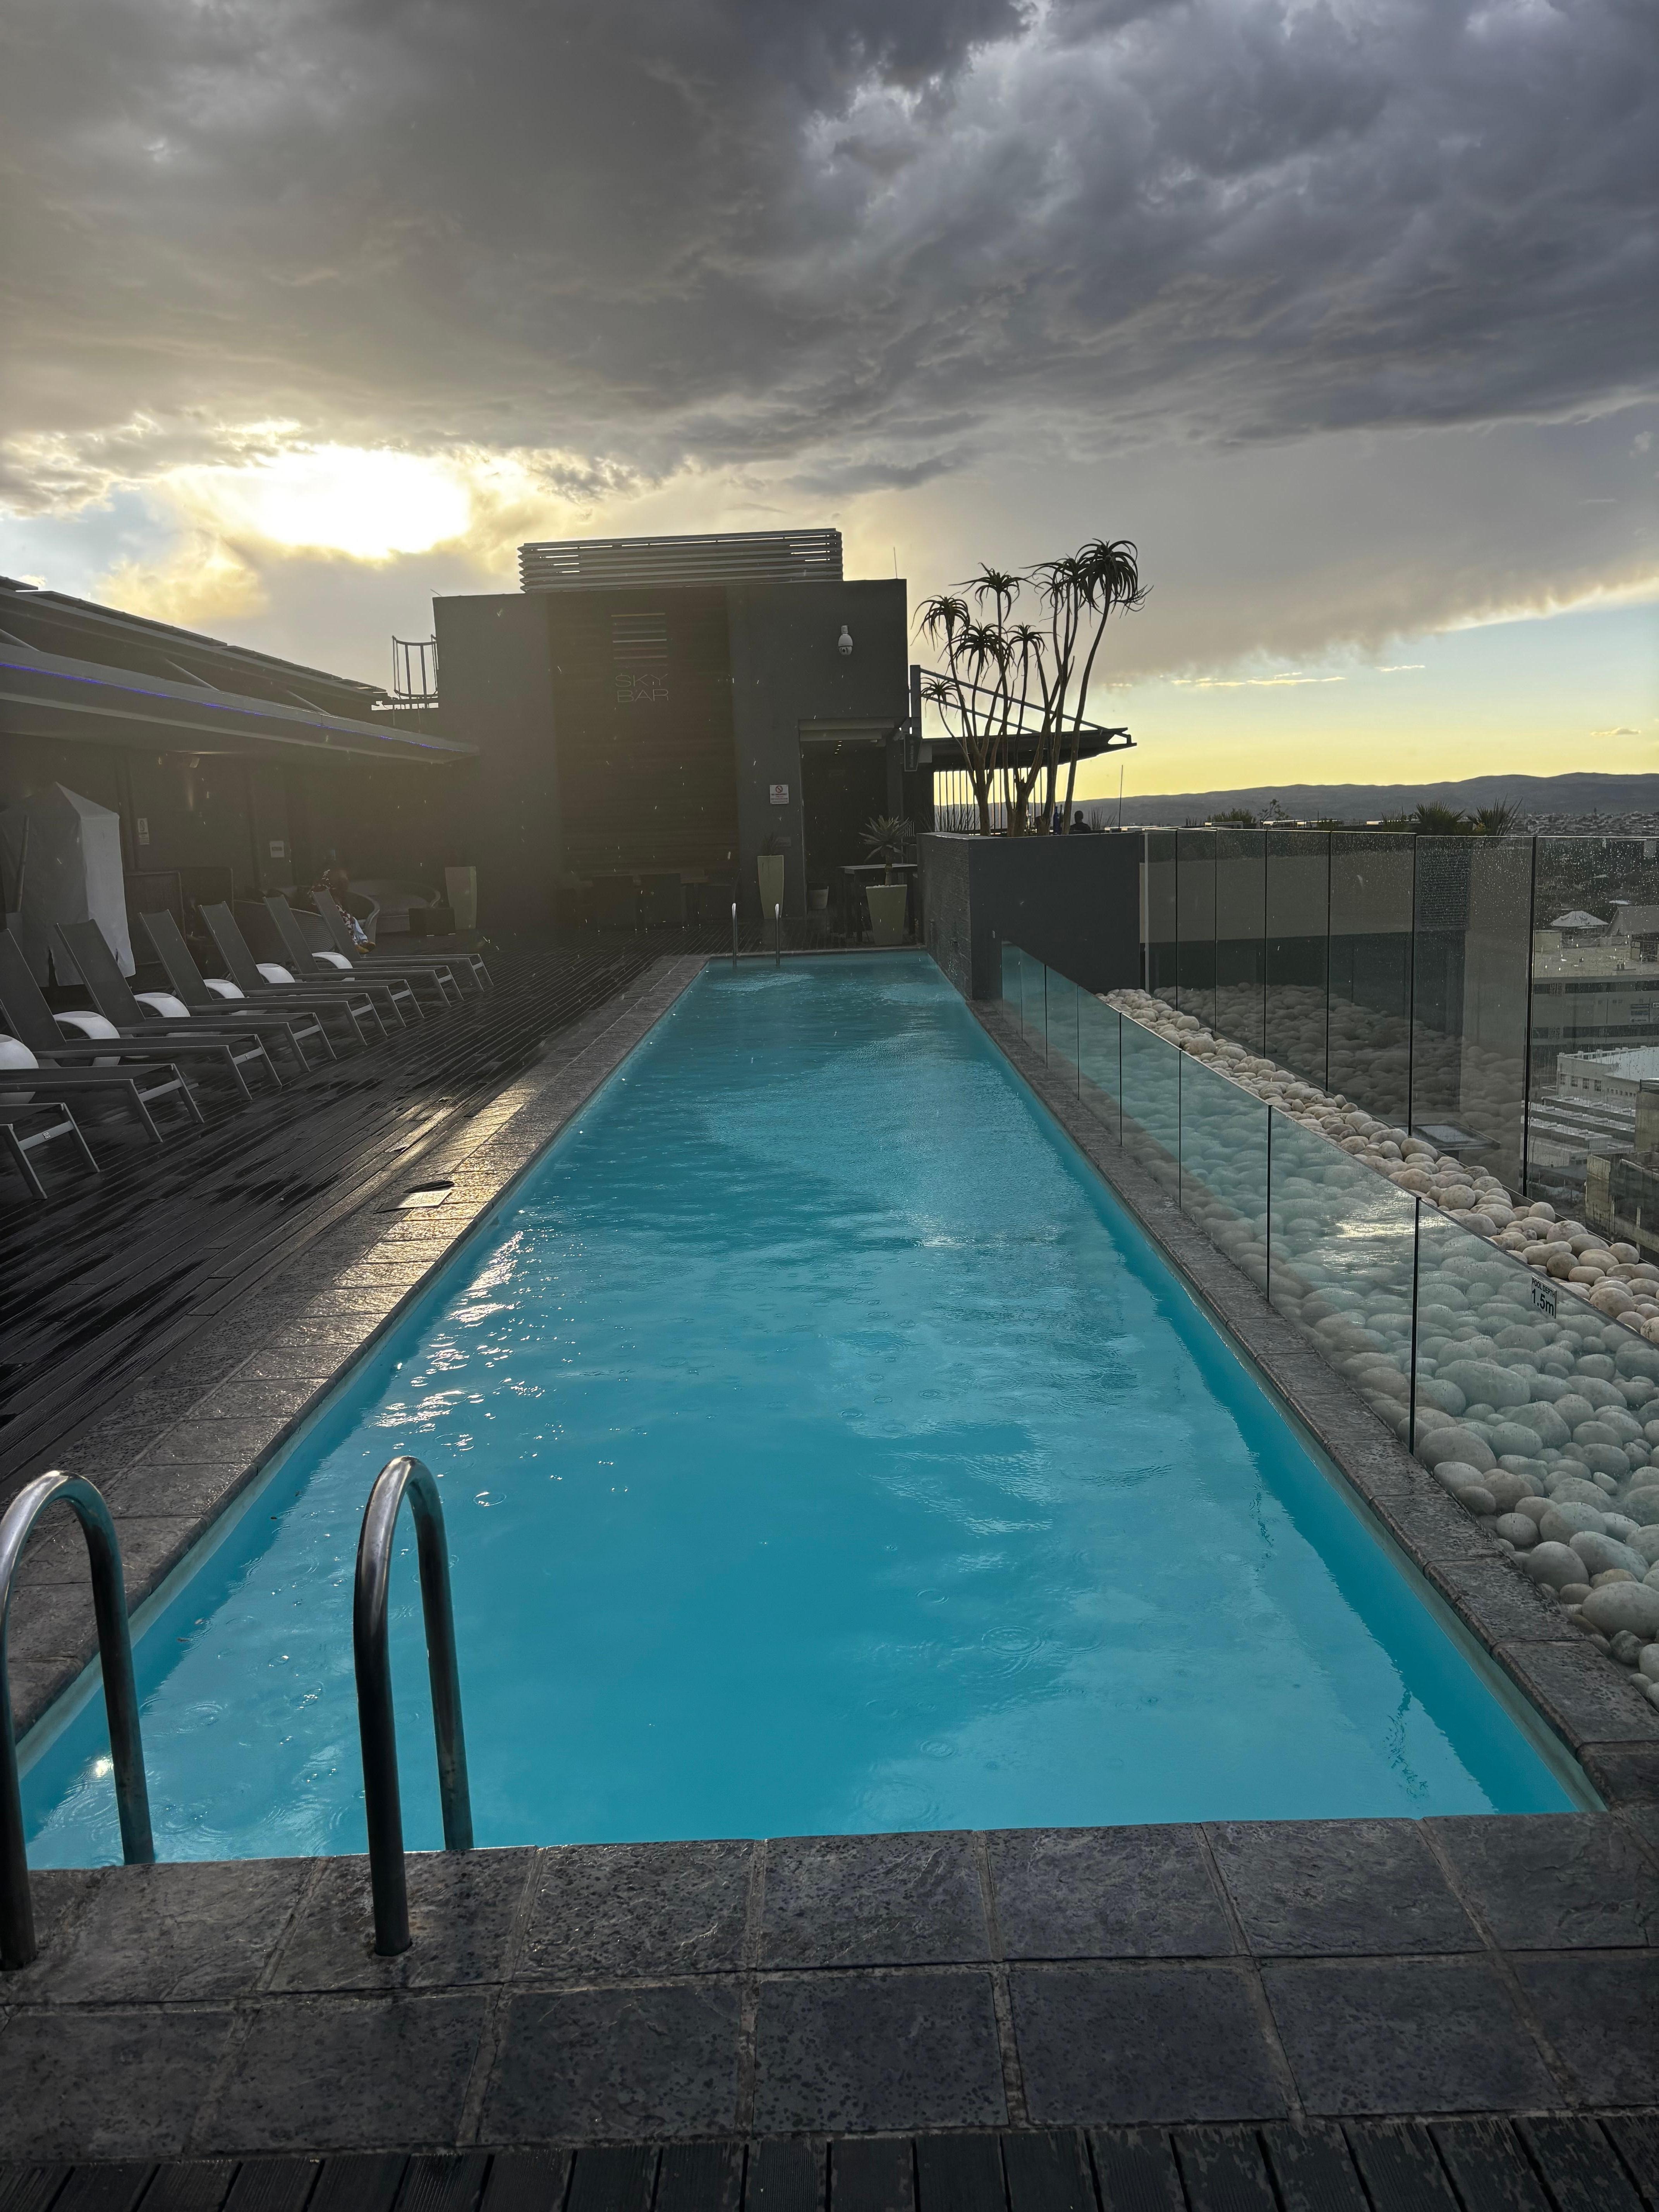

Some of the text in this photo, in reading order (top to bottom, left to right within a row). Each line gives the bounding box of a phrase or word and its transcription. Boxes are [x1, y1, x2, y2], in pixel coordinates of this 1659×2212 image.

[615, 673, 668, 687] SKY
[617, 689, 668, 702] BAR
[1532, 1278, 1555, 1298] POOL DEPTH
[1532, 1288, 1554, 1316] 1.5m
